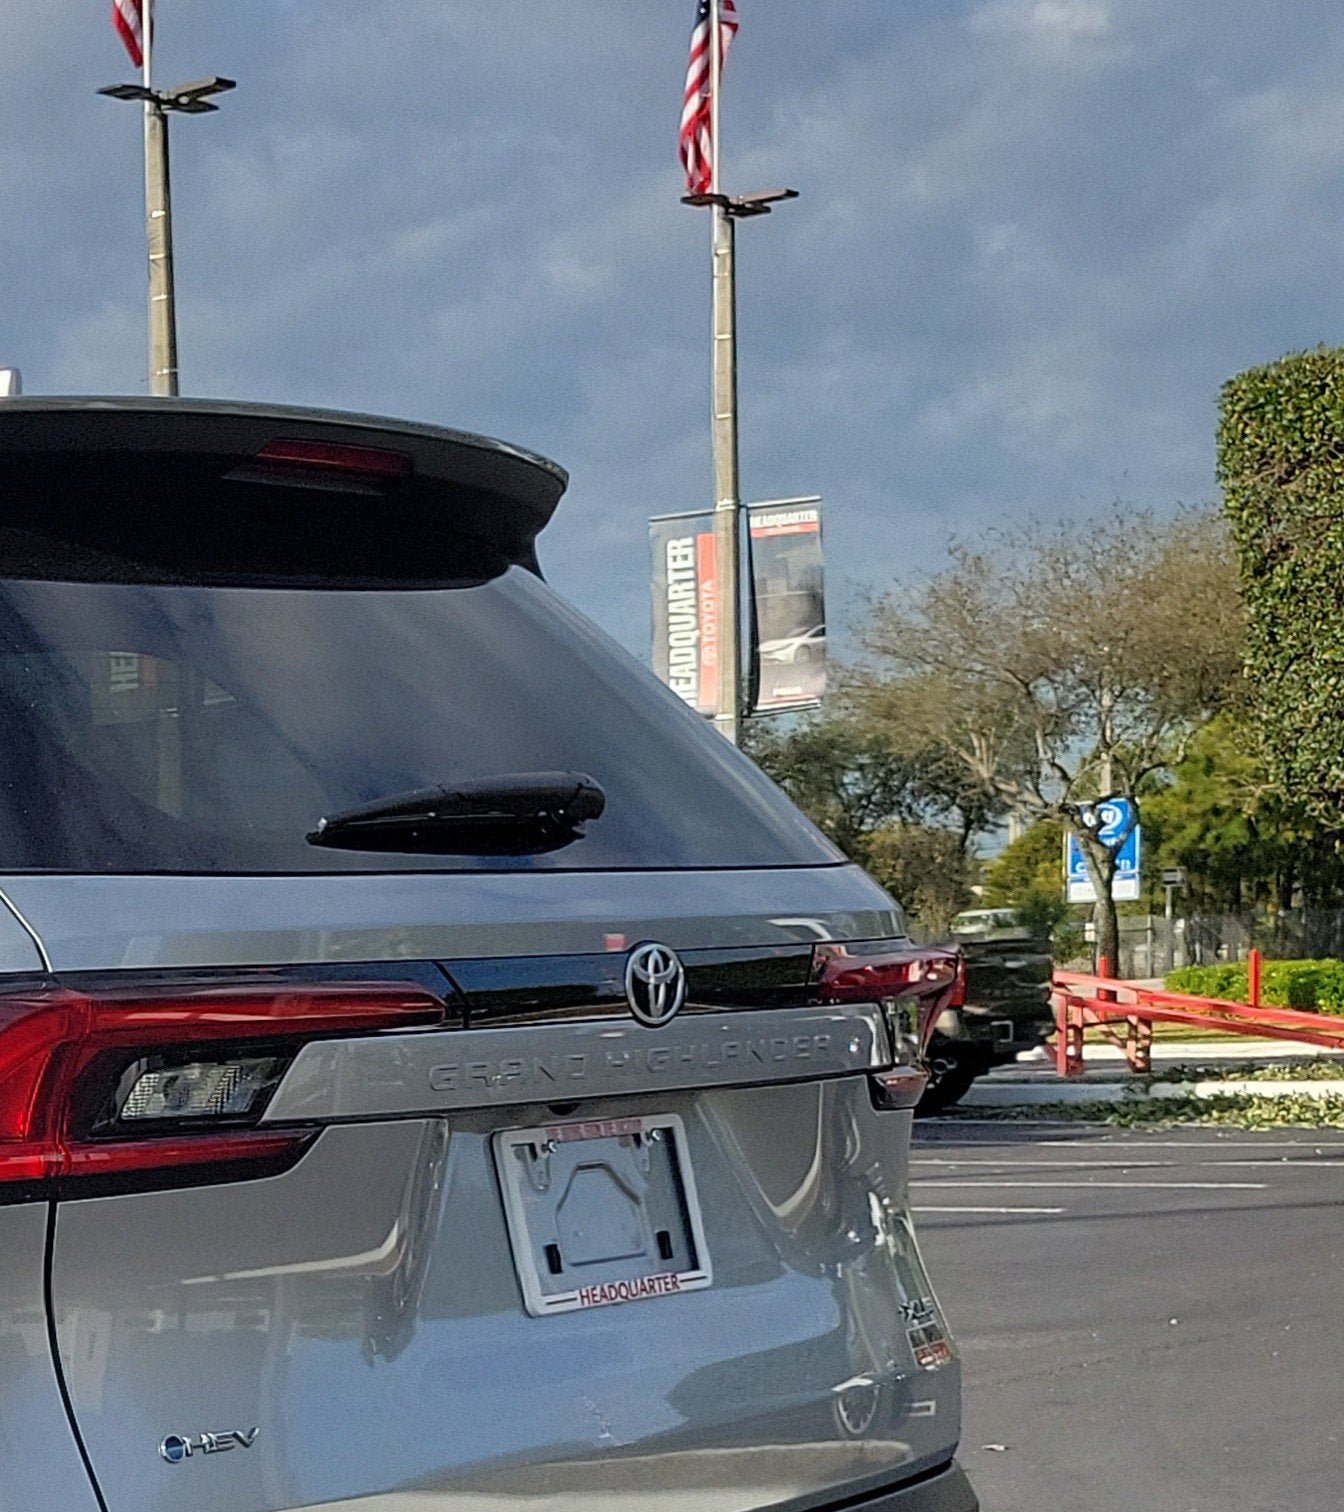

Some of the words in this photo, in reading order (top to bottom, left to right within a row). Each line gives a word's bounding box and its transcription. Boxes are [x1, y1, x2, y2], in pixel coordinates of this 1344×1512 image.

[428, 1053, 588, 1091] GRAND
[606, 1034, 832, 1077] HIGHLANDER
[579, 1274, 680, 1306] HEADQUARTER
[183, 1427, 260, 1457] HEV
